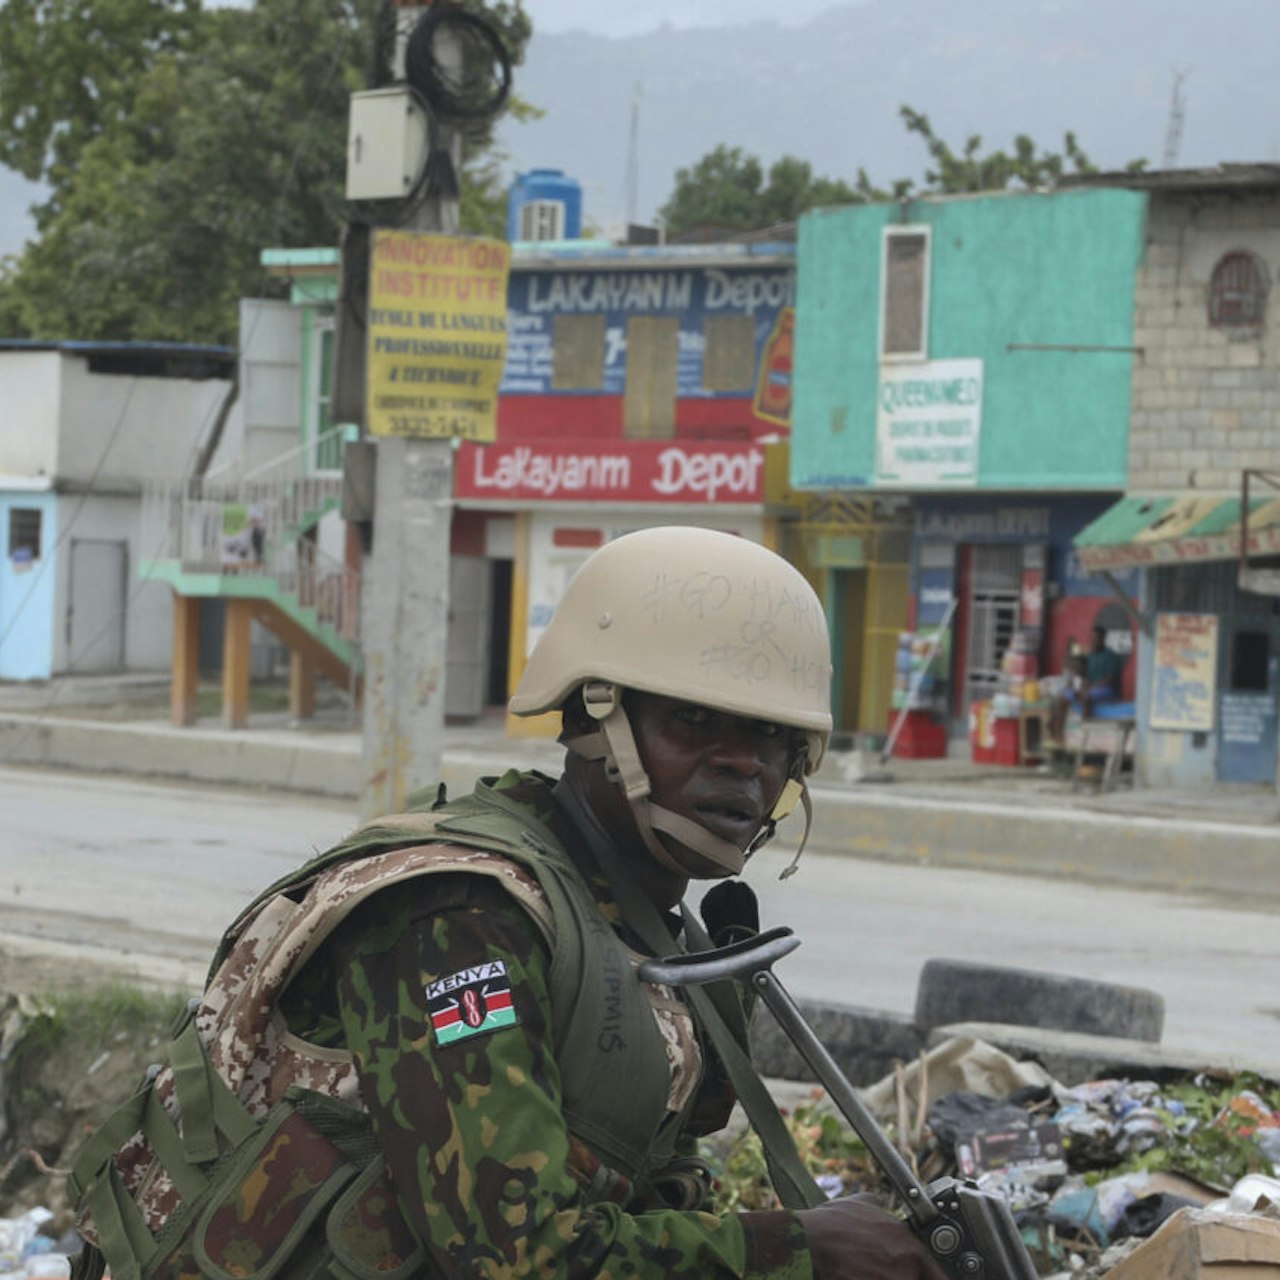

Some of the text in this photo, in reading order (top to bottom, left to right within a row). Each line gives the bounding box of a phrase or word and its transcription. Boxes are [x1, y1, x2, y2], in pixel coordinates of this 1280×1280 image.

[377, 236, 506, 271] INNOVATION
[378, 271, 502, 300] INSTITUTE
[528, 272, 692, 312] LAKAYANM
[652, 447, 764, 501] Depot
[428, 963, 504, 996] KENYA
